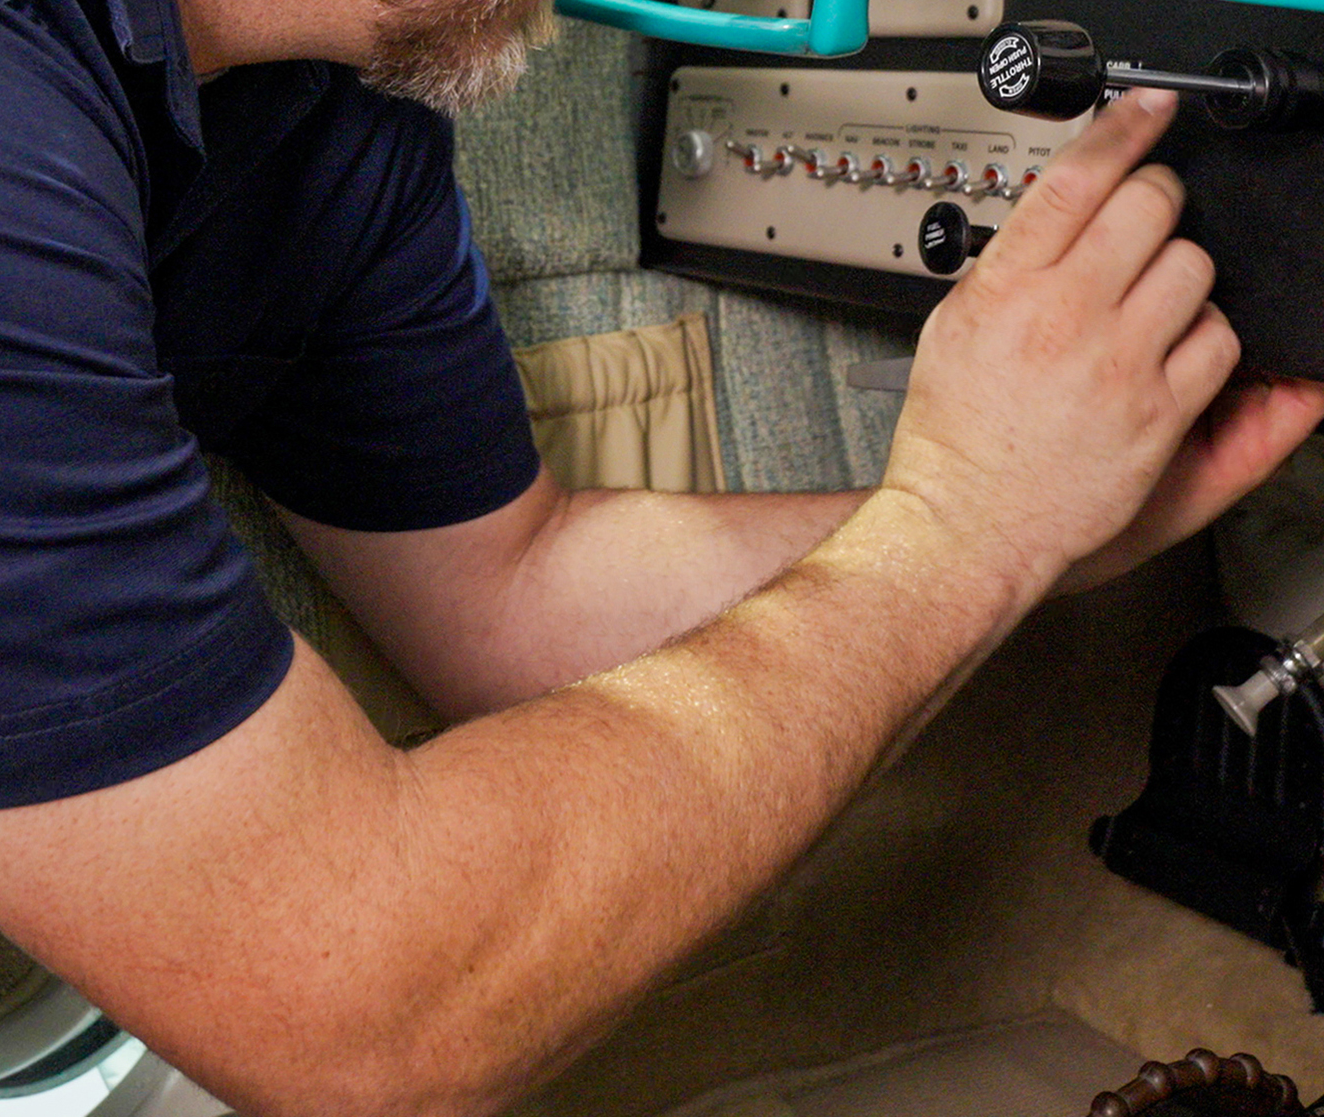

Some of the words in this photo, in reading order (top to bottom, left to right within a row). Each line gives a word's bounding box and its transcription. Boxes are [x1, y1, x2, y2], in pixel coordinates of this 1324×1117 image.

[1008, 46, 1028, 64] PUSH
[989, 58, 1009, 75] OPEN
[991, 57, 1033, 90] THROTTLE
[952, 142, 968, 151] TAXI
[988, 145, 1009, 154] LAND
[1028, 147, 1051, 157] PITOT
